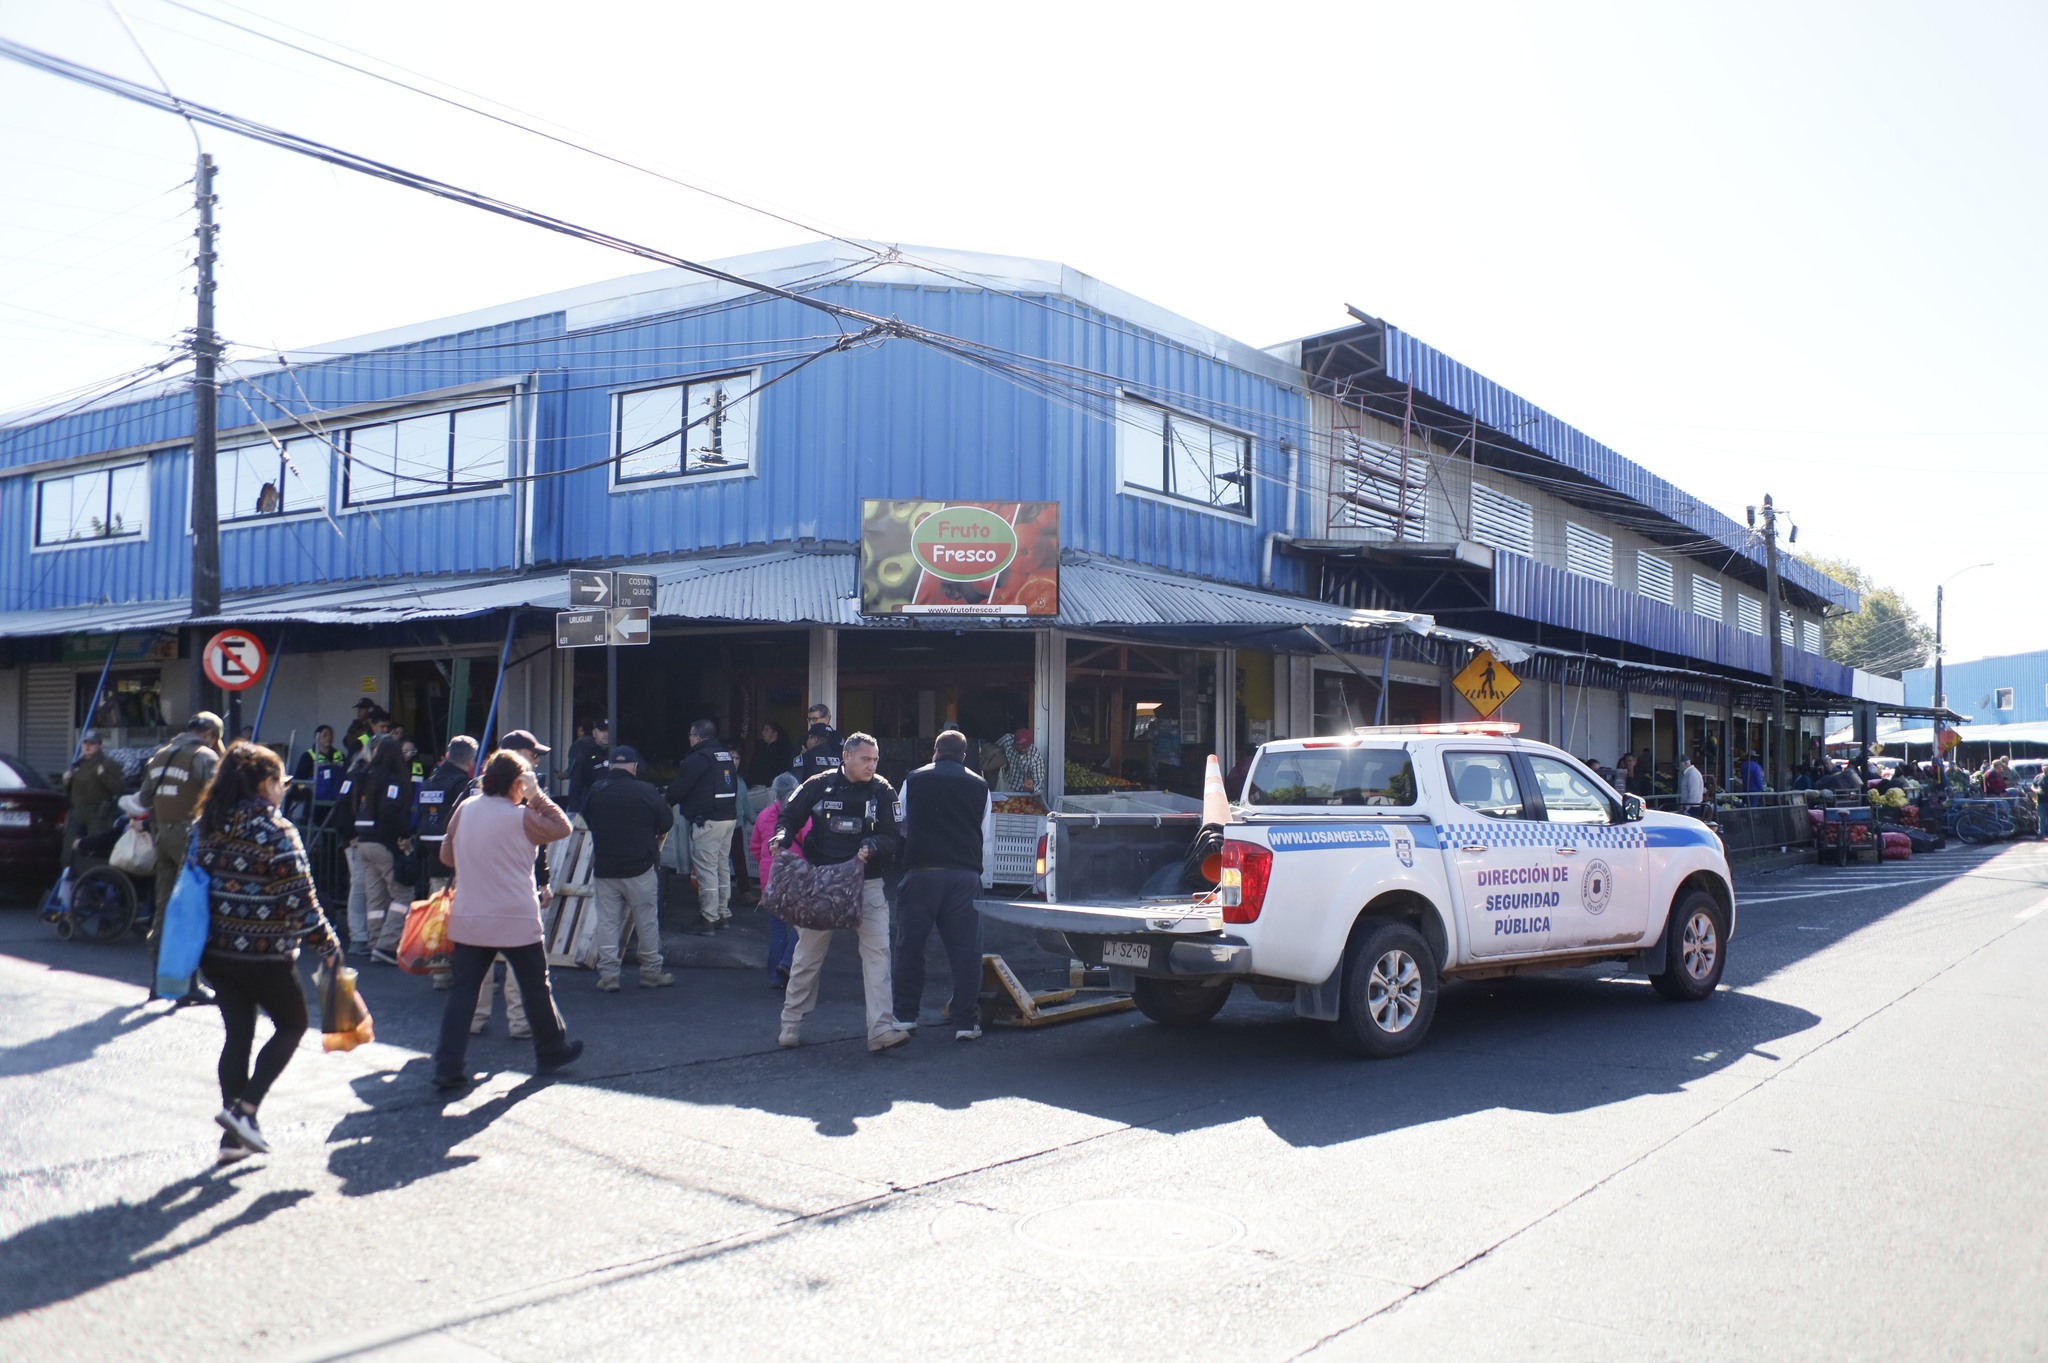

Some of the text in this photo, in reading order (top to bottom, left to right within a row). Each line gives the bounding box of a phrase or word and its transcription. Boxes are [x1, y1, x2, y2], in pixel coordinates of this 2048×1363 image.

[938, 520, 991, 538] Fruto
[932, 545, 997, 562] Fresco
[927, 606, 1002, 614] www.frutofresco.cl
[568, 615, 593, 624] URUGUAY
[222, 641, 246, 676] E
[1268, 829, 1390, 845] WWW.LOSANGELES.CL
[1477, 863, 1569, 887] DIRECCIÓN DE
[1486, 891, 1560, 912] SEGURIDAD
[1494, 915, 1551, 936] PÚBLICA
